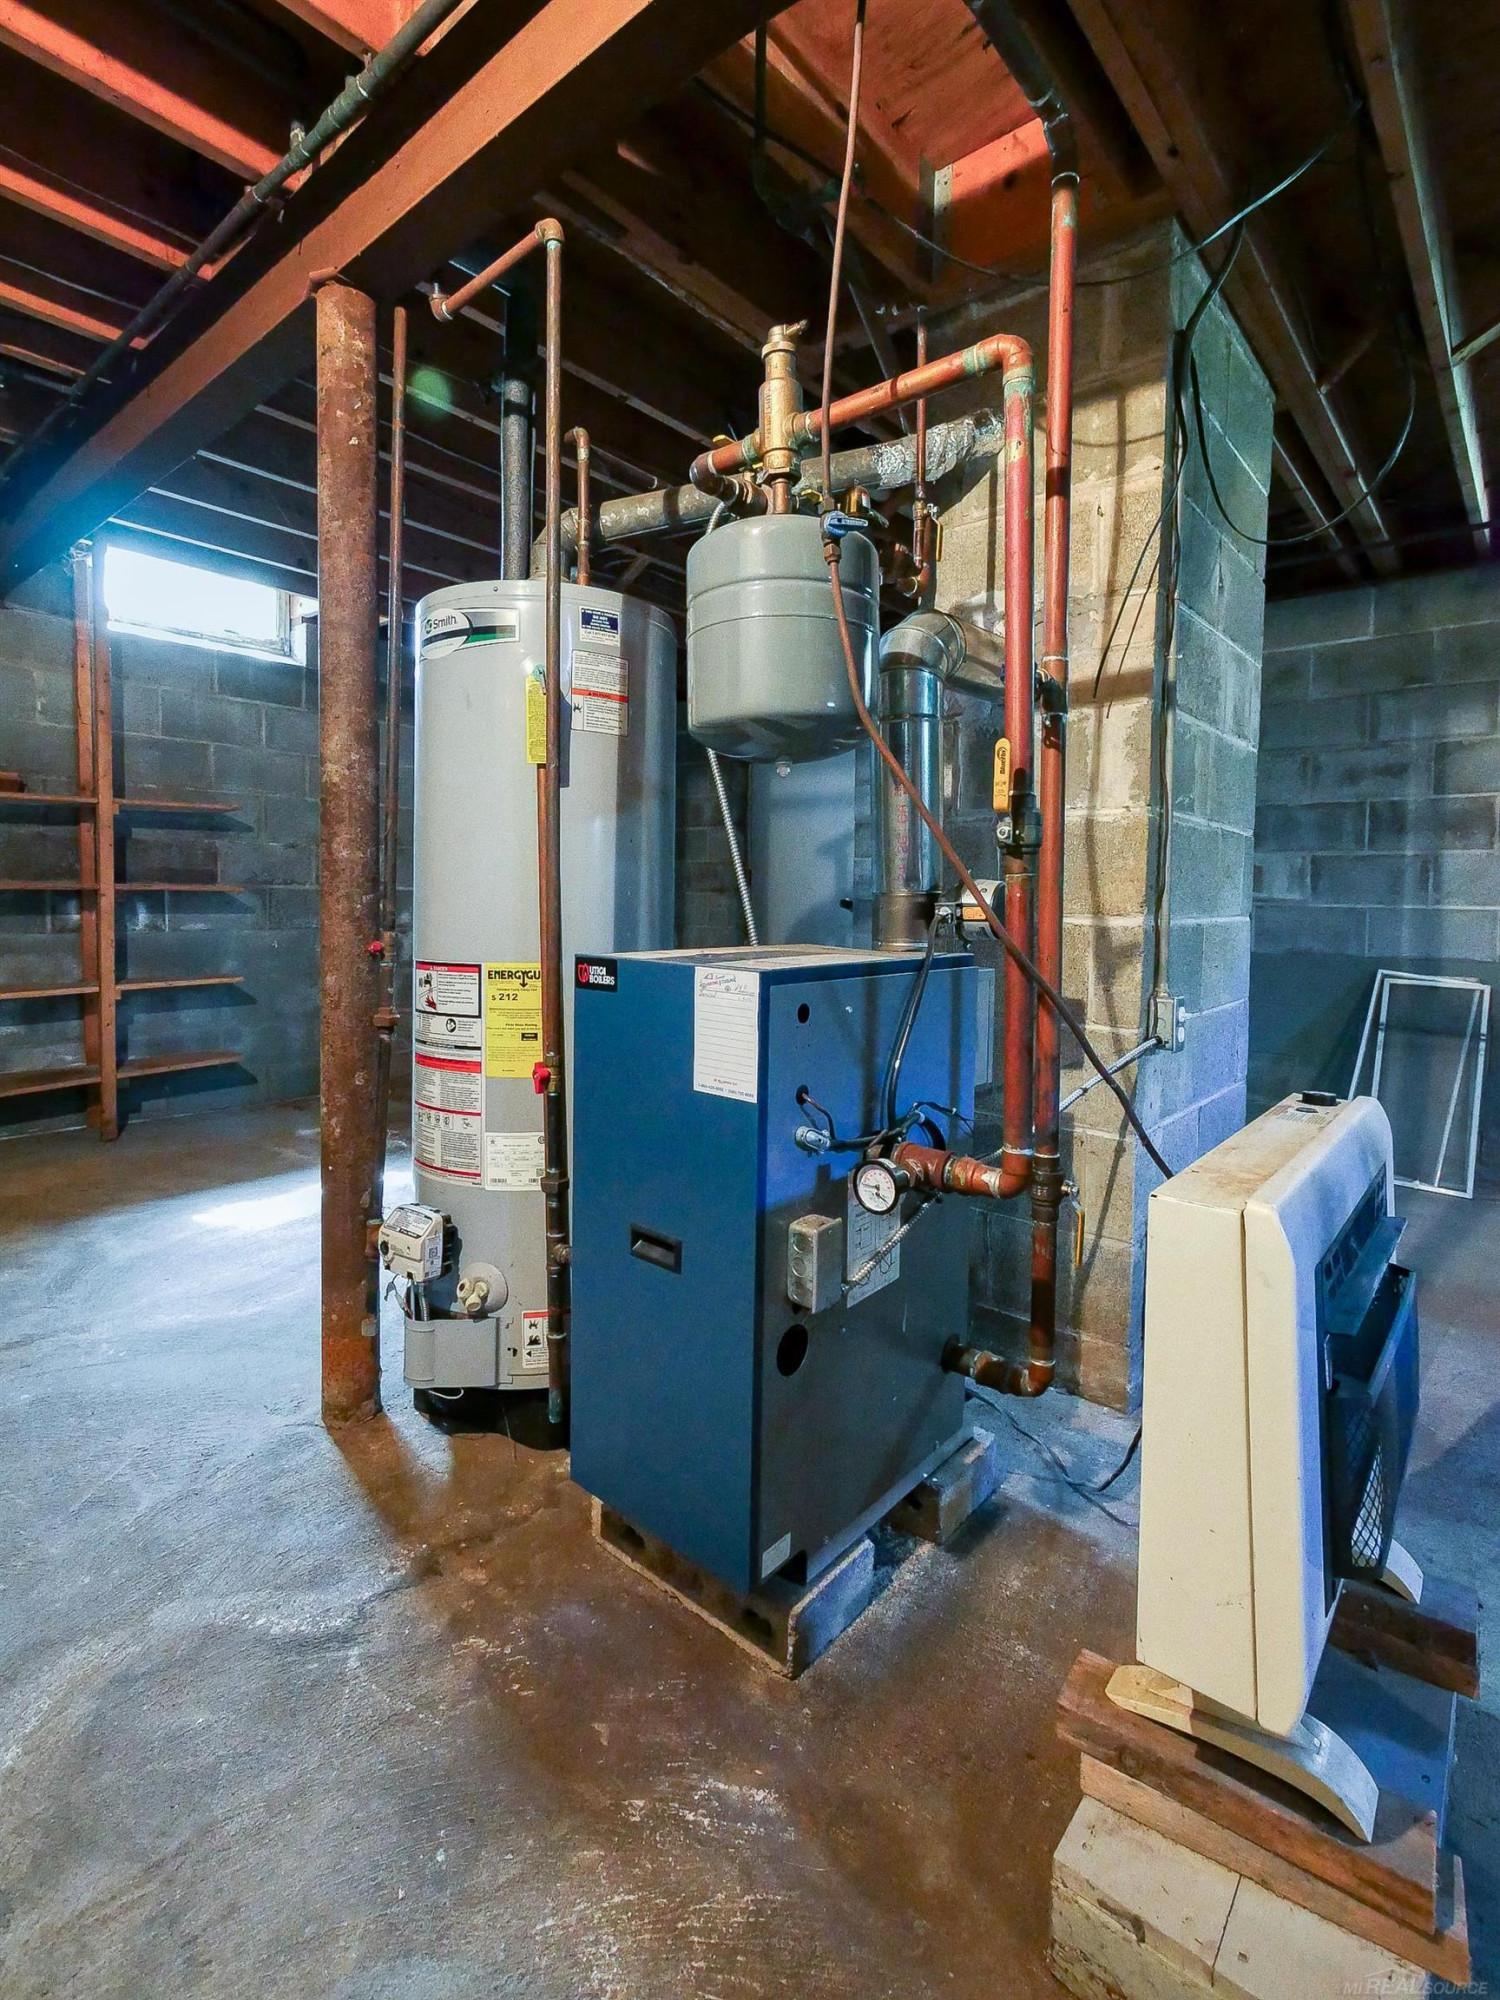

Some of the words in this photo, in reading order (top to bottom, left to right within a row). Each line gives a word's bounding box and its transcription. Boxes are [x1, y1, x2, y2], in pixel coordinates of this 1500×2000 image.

[433, 615, 457, 630] Smith
[488, 970, 541, 982] ENERGYGU
[589, 966, 606, 976] UTICA
[589, 975, 615, 986] BOILERS
[499, 993, 518, 1001] 212
